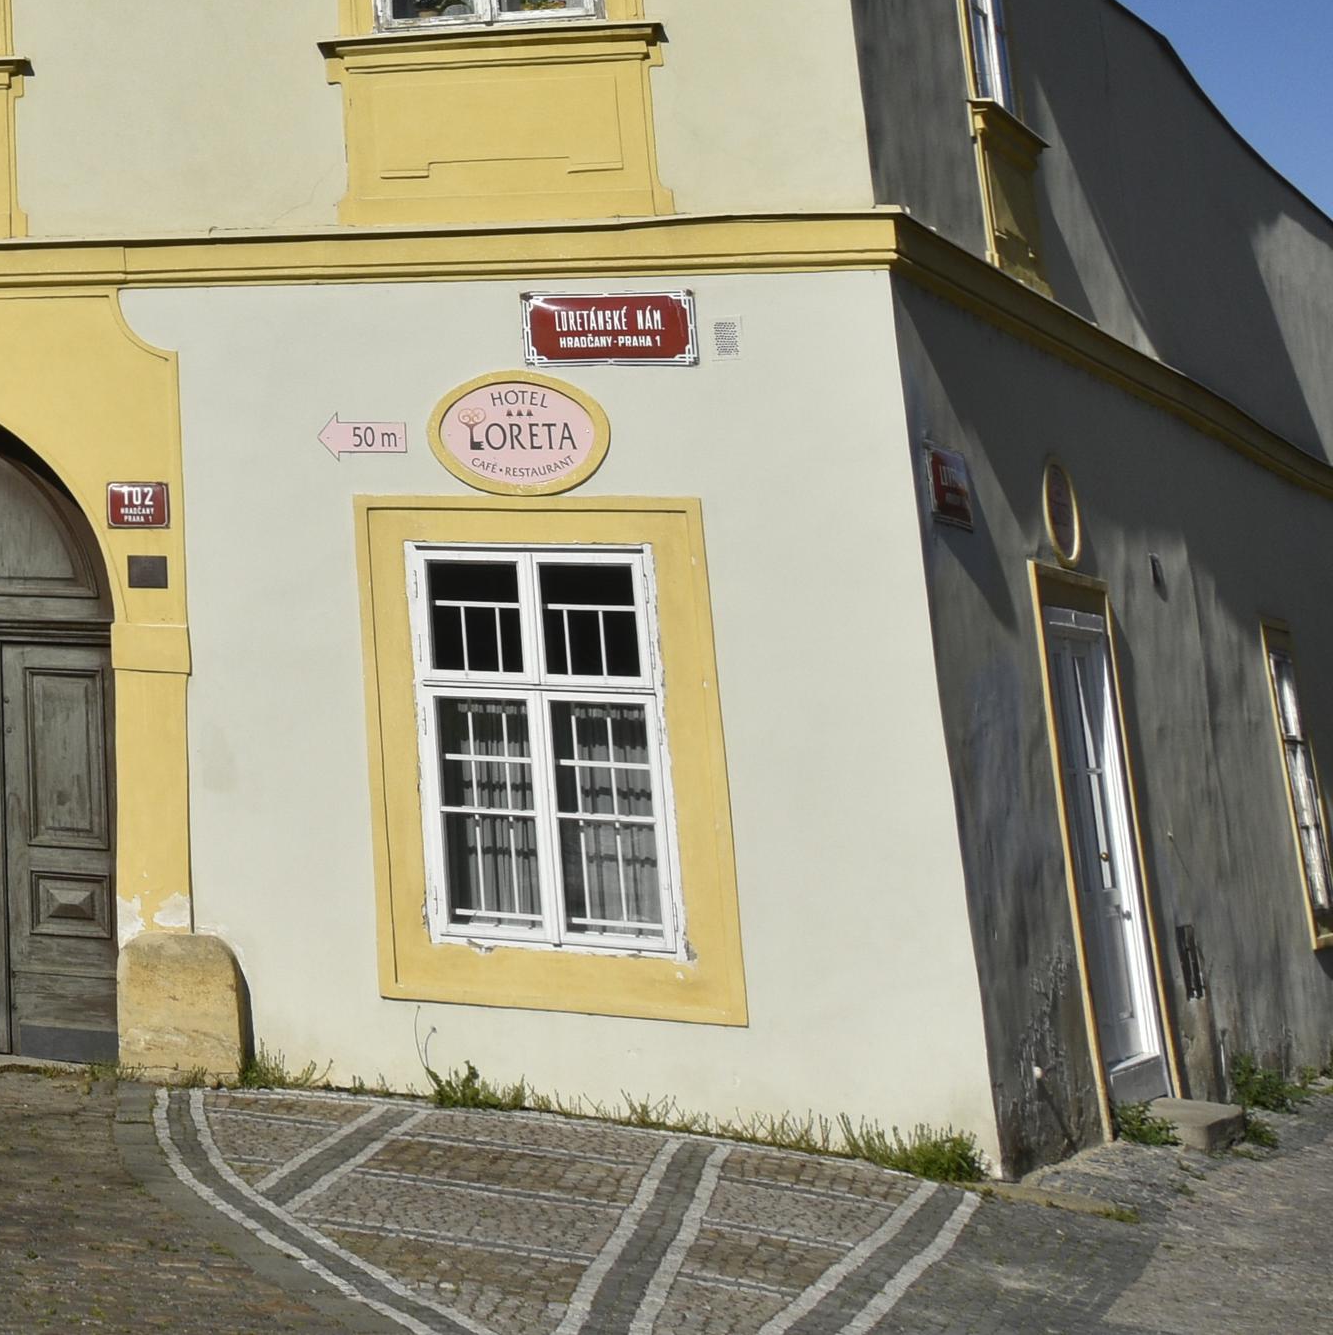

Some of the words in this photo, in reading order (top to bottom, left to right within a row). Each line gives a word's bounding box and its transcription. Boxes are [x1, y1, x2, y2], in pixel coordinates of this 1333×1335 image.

[554, 306, 628, 332] LORETÁNSKÉ
[636, 305, 665, 330] NÁM.
[655, 335, 661, 347] 1
[490, 390, 548, 408] HOTEL
[352, 426, 375, 447] 50
[381, 432, 397, 447] m
[469, 421, 578, 451] LORETA
[471, 457, 497, 474] CAFÉ
[504, 455, 575, 477] RESTAURANT
[123, 487, 153, 505] 102
[120, 506, 154, 514] HRADČANY
